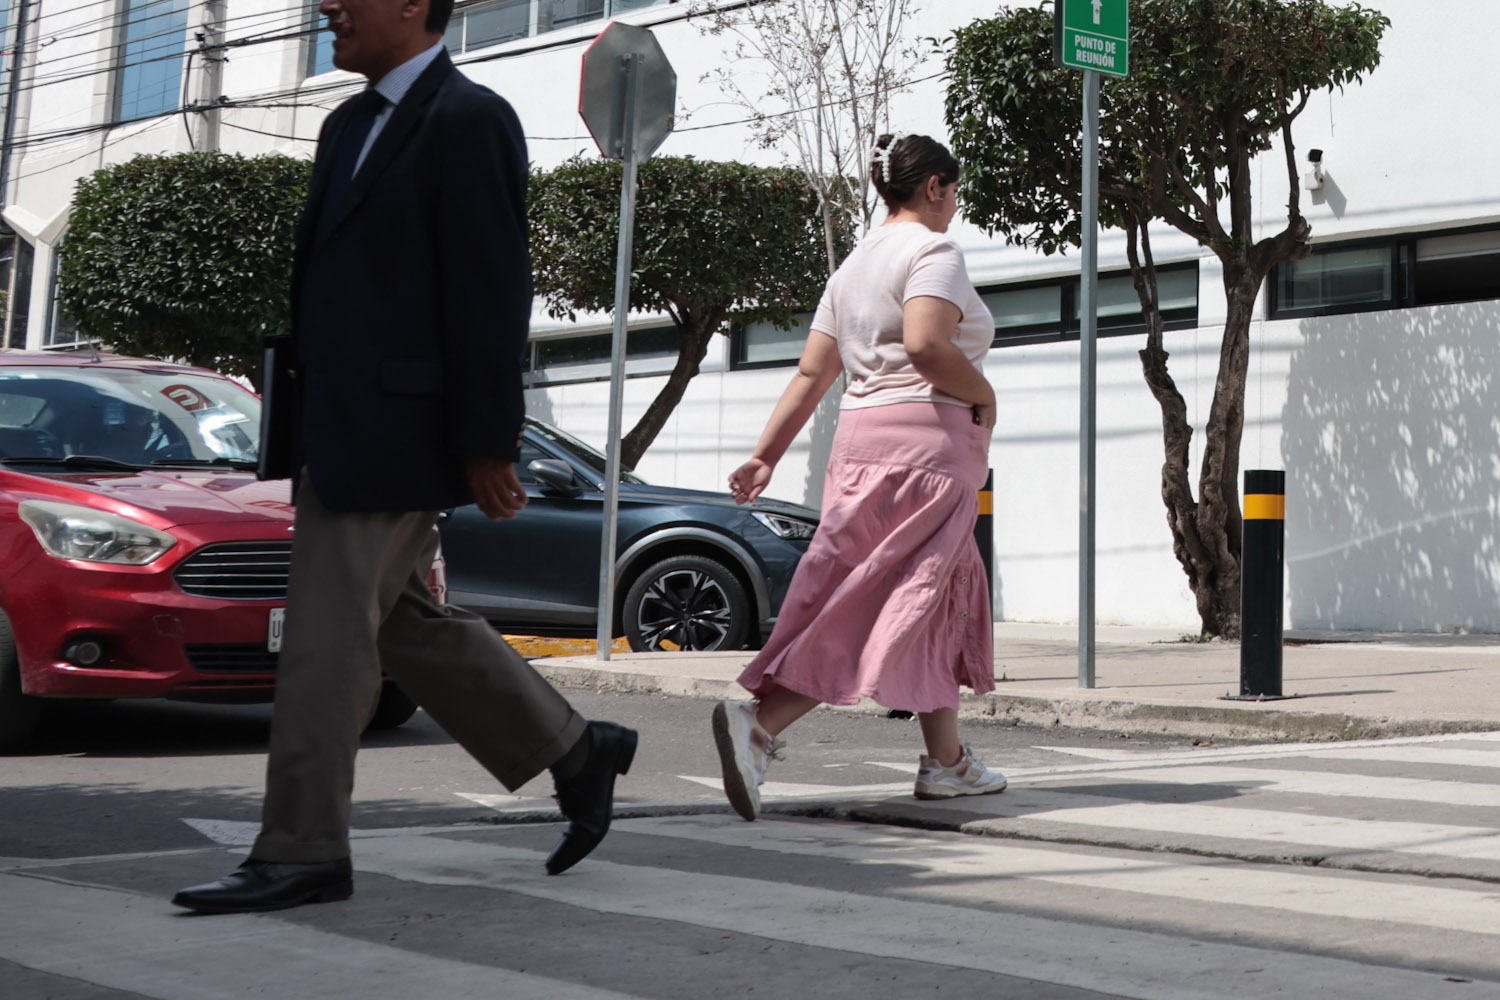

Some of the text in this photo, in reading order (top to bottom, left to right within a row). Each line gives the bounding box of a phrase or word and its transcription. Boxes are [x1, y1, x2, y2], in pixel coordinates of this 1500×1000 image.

[1074, 34, 1116, 54] PUNTO DE
[1075, 49, 1115, 68] REUNIÓN
